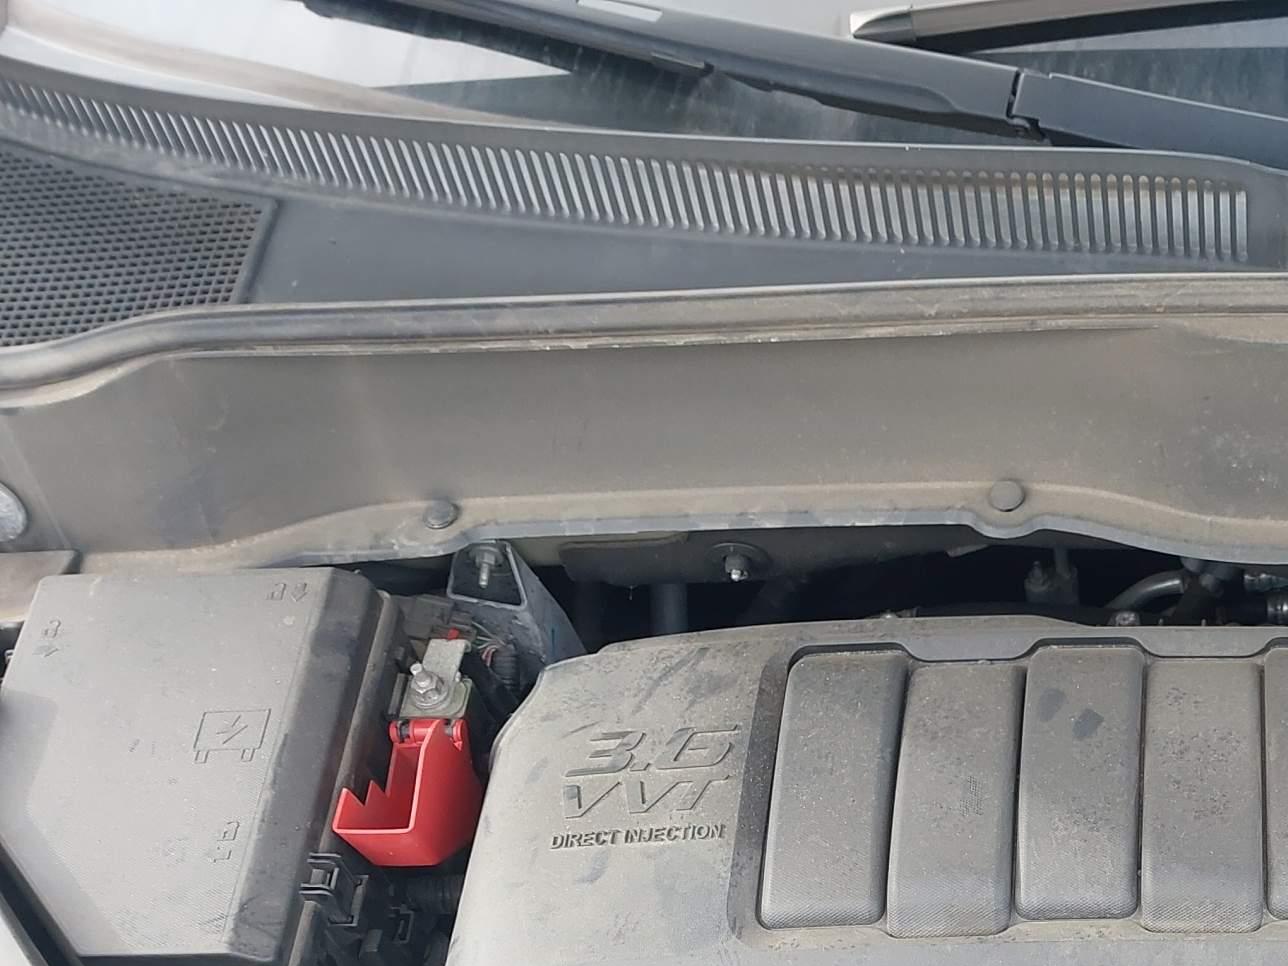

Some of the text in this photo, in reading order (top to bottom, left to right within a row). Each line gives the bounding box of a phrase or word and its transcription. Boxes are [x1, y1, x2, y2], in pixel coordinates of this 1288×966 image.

[563, 724, 740, 777] 3.6
[562, 774, 733, 819] VVT
[550, 824, 727, 849] DIRECT INJECTION
